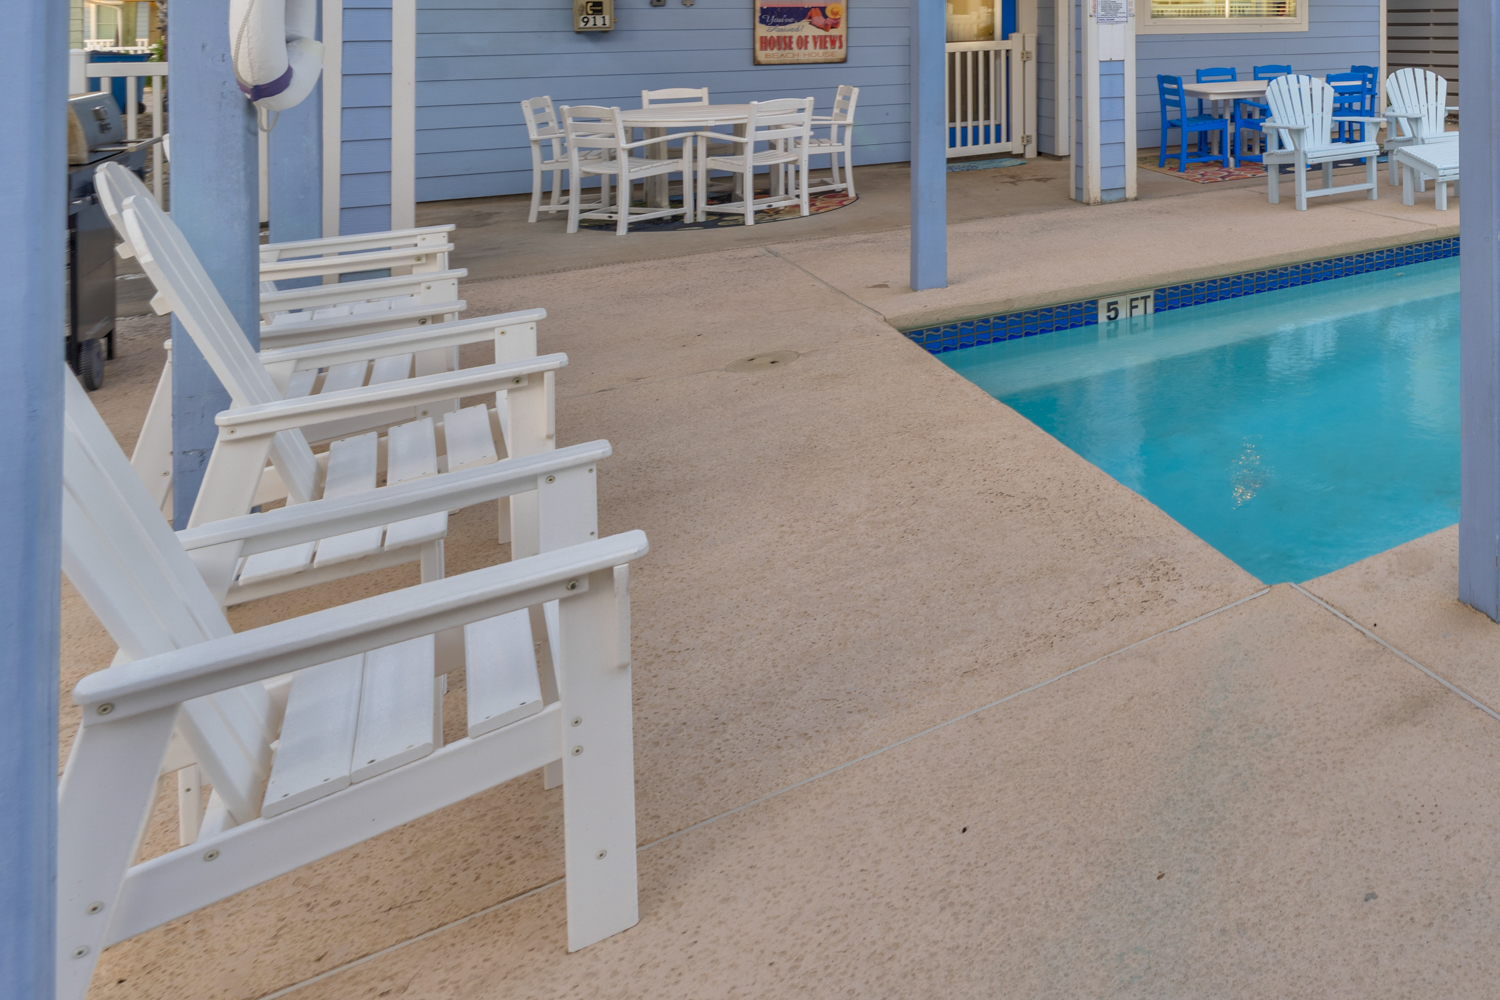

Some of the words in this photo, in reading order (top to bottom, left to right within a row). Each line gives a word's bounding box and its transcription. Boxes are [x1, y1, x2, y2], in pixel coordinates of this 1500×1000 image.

[581, 15, 608, 27] 911
[759, 35, 794, 51] HOUSE
[796, 35, 809, 50] OF
[812, 34, 843, 50] VIEWS
[1106, 300, 1120, 321] 5
[1129, 295, 1151, 317] FT
